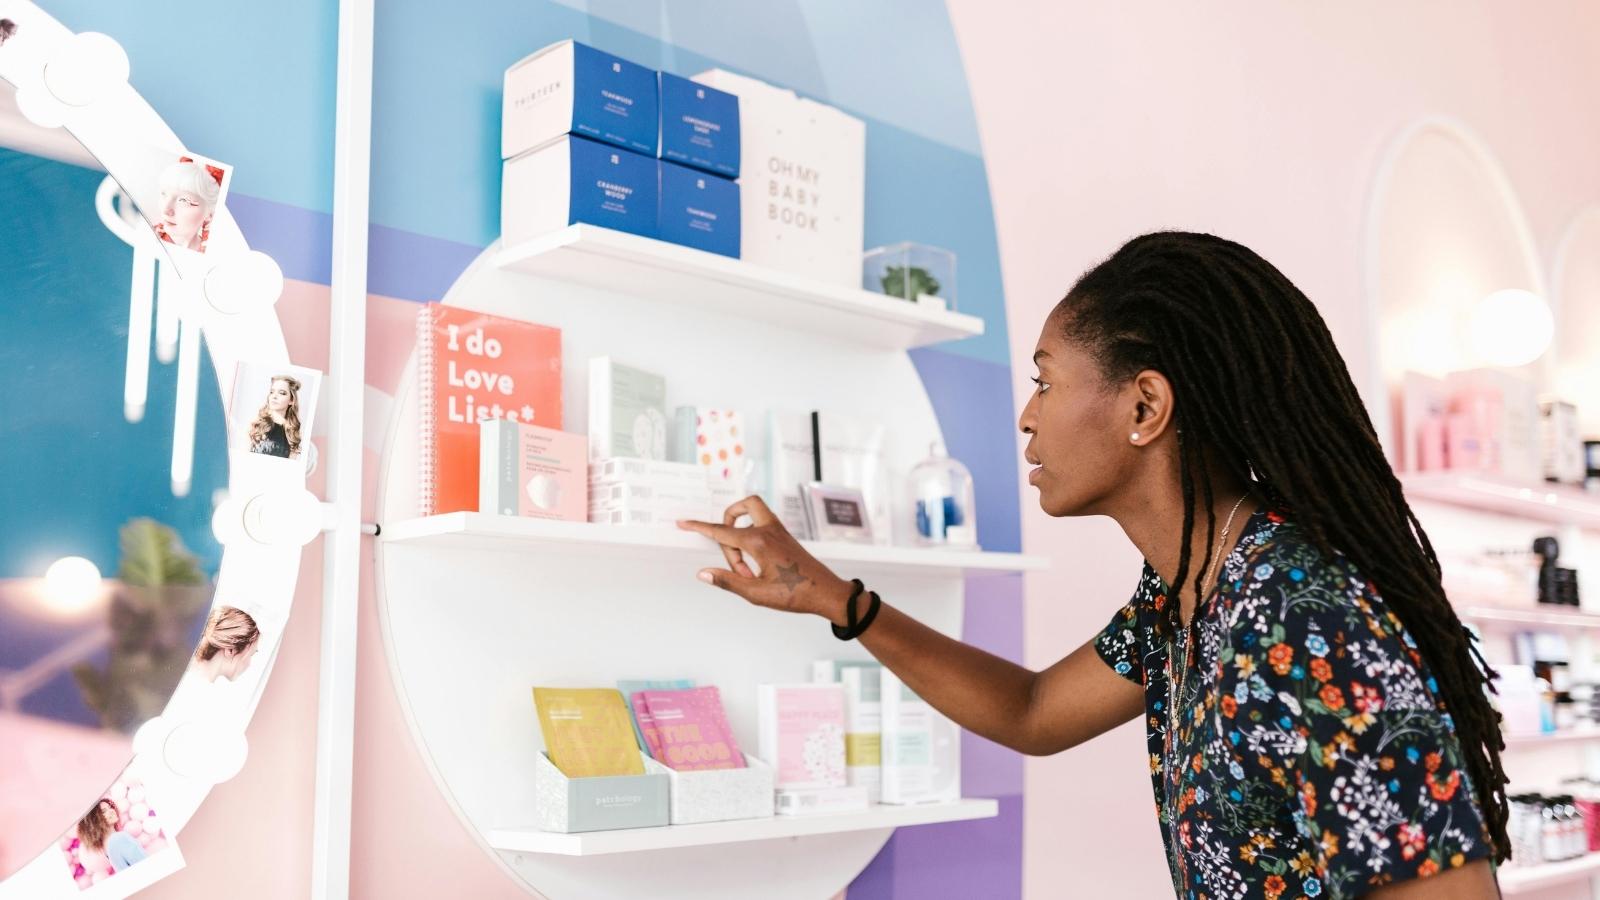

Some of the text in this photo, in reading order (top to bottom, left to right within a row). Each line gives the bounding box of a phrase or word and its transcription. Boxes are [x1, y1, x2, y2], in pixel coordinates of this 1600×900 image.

[767, 156, 820, 185] OH MY
[768, 179, 821, 208] BABY
[768, 203, 819, 232] BOOK
[447, 323, 503, 359] I do
[448, 359, 515, 396] Love
